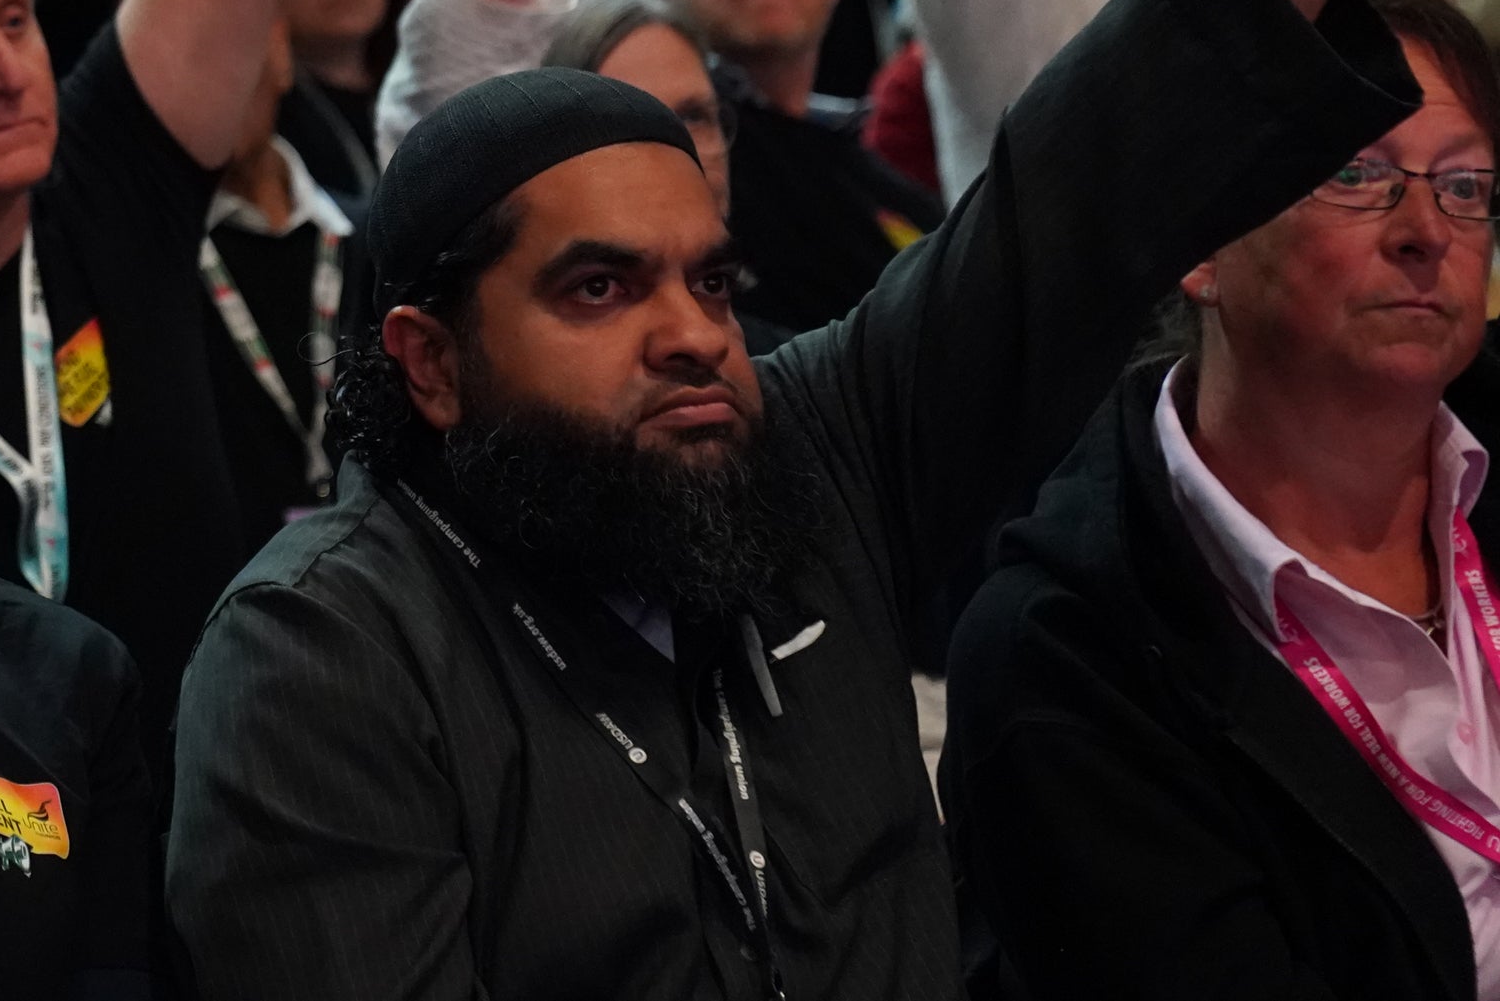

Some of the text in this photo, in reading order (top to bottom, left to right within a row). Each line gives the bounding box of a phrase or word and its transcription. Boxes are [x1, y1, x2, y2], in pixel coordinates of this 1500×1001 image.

[397, 477, 482, 569] The campaigning union
[1464, 569, 1500, 627] WORKERS
[512, 602, 567, 671] usdaw.org.uk
[1302, 656, 1351, 712] WORKERS
[595, 712, 634, 750] USDAW
[1344, 707, 1363, 731] FOR
[715, 690, 744, 767] campaigning
[734, 764, 749, 800] union
[1356, 728, 1382, 755] DEAL
[1375, 752, 1401, 780] NEW
[1404, 781, 1432, 807] FOR
[678, 797, 706, 833] union
[1427, 800, 1485, 841] FIGHTING
